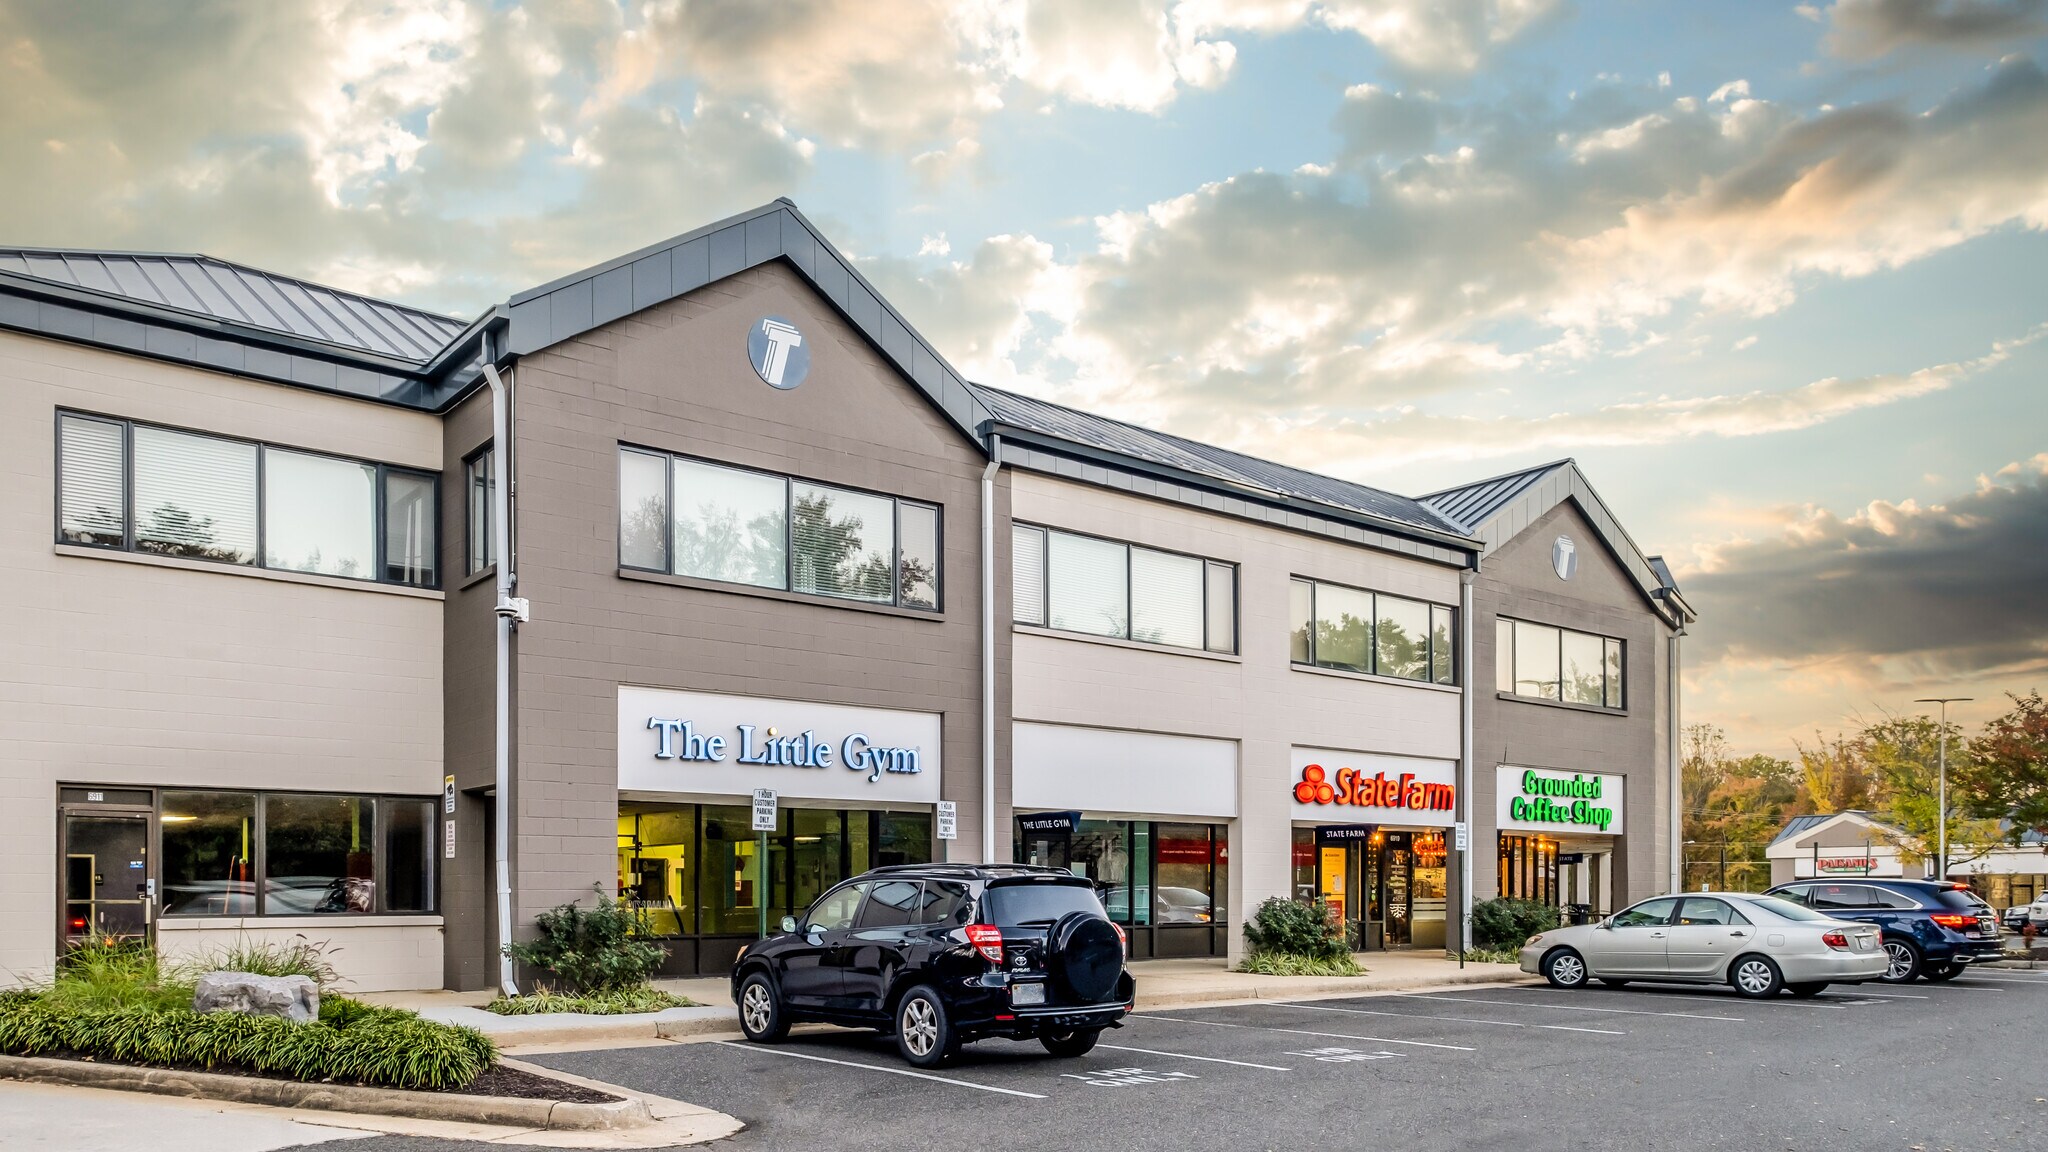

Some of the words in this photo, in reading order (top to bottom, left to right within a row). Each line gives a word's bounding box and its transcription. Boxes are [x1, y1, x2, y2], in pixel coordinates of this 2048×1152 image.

[762, 318, 802, 386] T
[647, 715, 728, 762] The
[736, 723, 834, 769] Little
[840, 732, 922, 783] Gym
[1521, 769, 1603, 799] Grounded
[754, 799, 775, 807] CUSTOMER
[756, 807, 772, 815] PARKING
[1510, 795, 1570, 823] Coffee
[1571, 799, 1613, 832] Shop
[759, 815, 769, 823] ONLY
[1022, 821, 1034, 829] THE
[1034, 819, 1052, 828] LITTLE
[1053, 818, 1070, 827] GYM
[1325, 830, 1344, 838] STATE
[1345, 829, 1365, 837] FARM
[1085, 1071, 1200, 1087] ONLY
